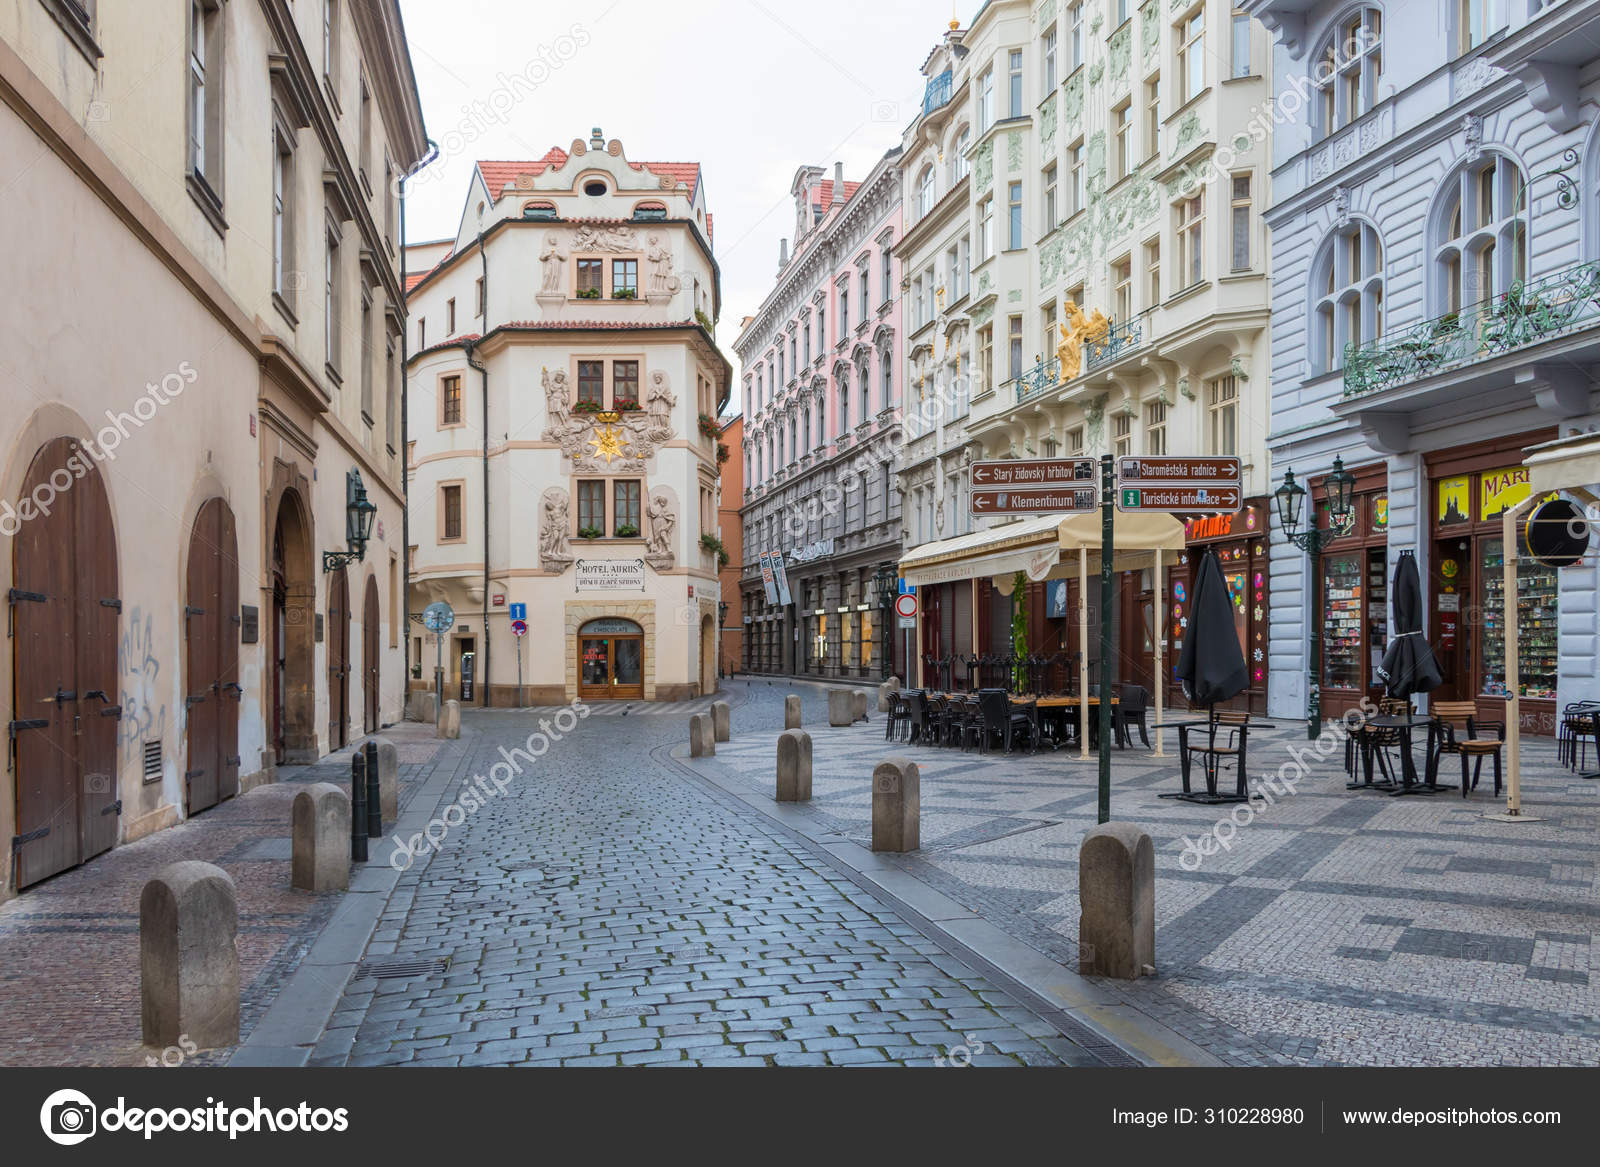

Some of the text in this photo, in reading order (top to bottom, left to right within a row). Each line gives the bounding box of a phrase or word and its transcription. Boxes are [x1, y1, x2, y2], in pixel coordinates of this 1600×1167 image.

[993, 463, 1073, 482] Starý židovský hřbitov
[1141, 463, 1217, 477] Staroměstská radnice
[1011, 494, 1073, 508] Klementinum
[1142, 491, 1179, 505] Turistické
[582, 565, 638, 574] HOTEL AURUS
